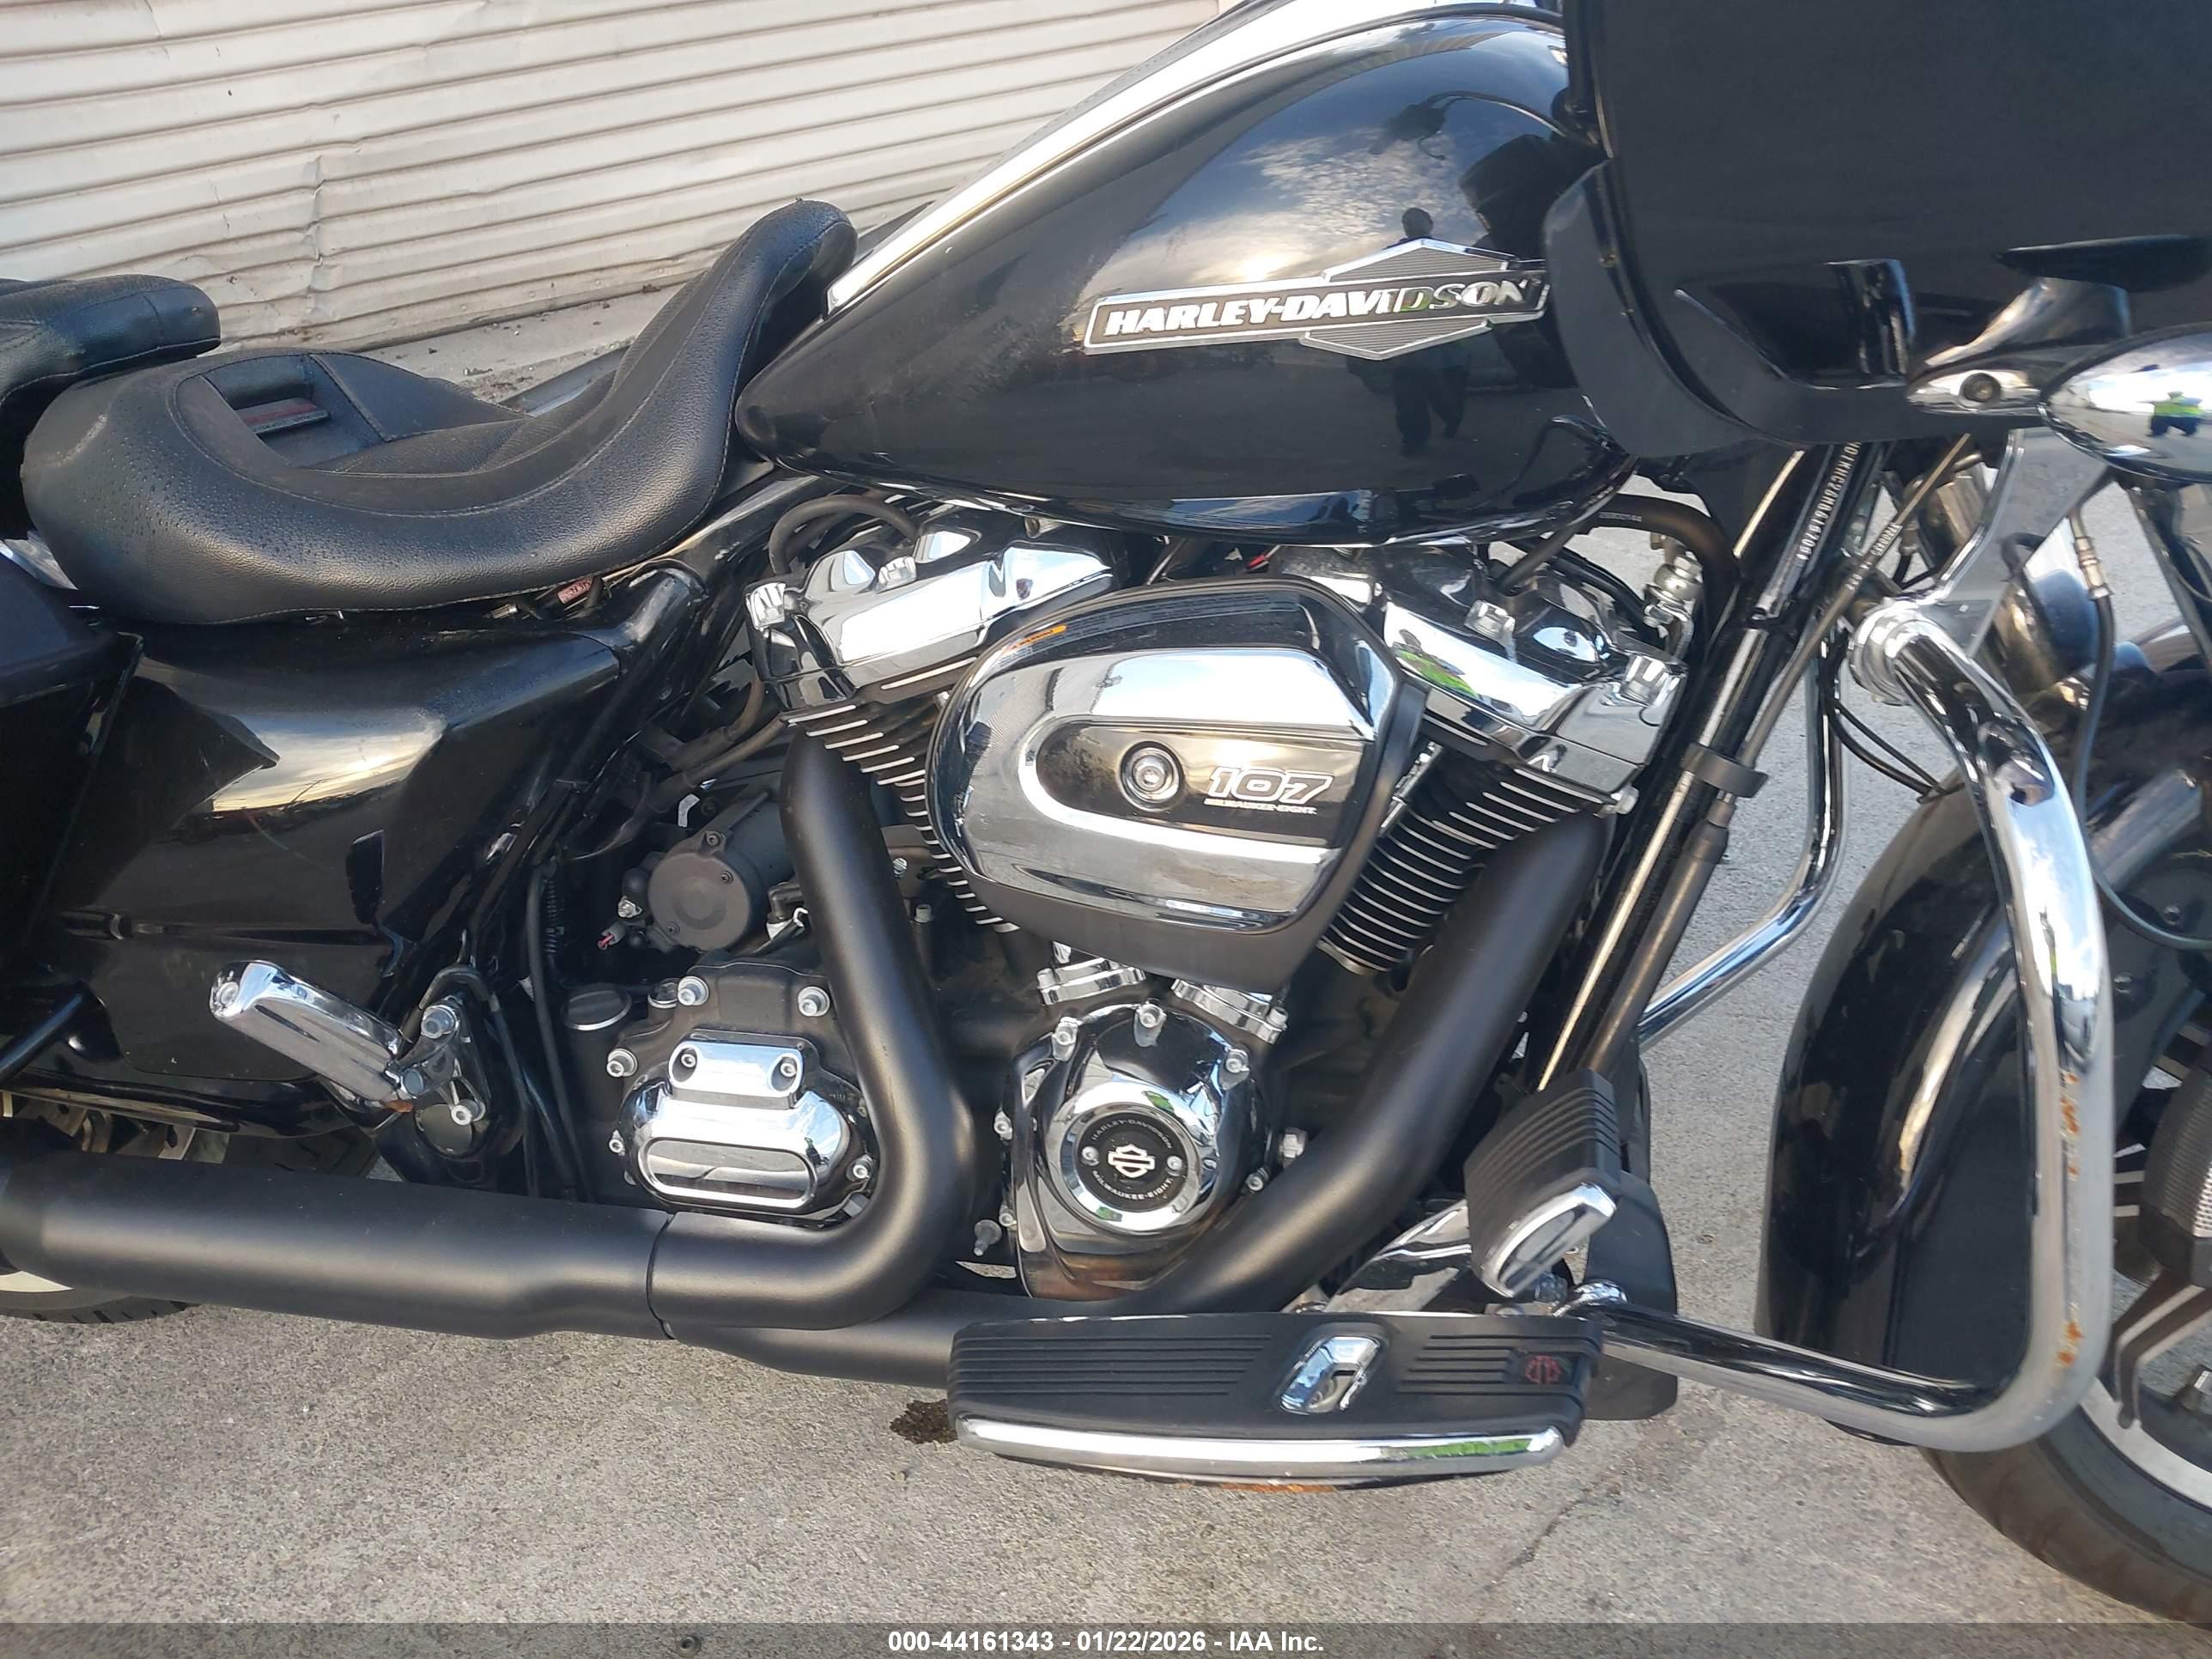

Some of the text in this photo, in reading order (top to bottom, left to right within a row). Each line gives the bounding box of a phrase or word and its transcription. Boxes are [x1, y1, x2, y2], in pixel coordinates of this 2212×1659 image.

[1103, 279, 1528, 337] HARLEY-DAVIDSON
[1207, 767, 1333, 804] 107
[1091, 1119, 1173, 1149] HARLEY-DAVIDSON
[1092, 1170, 1174, 1200] MILWAUKEE-EIGHT
